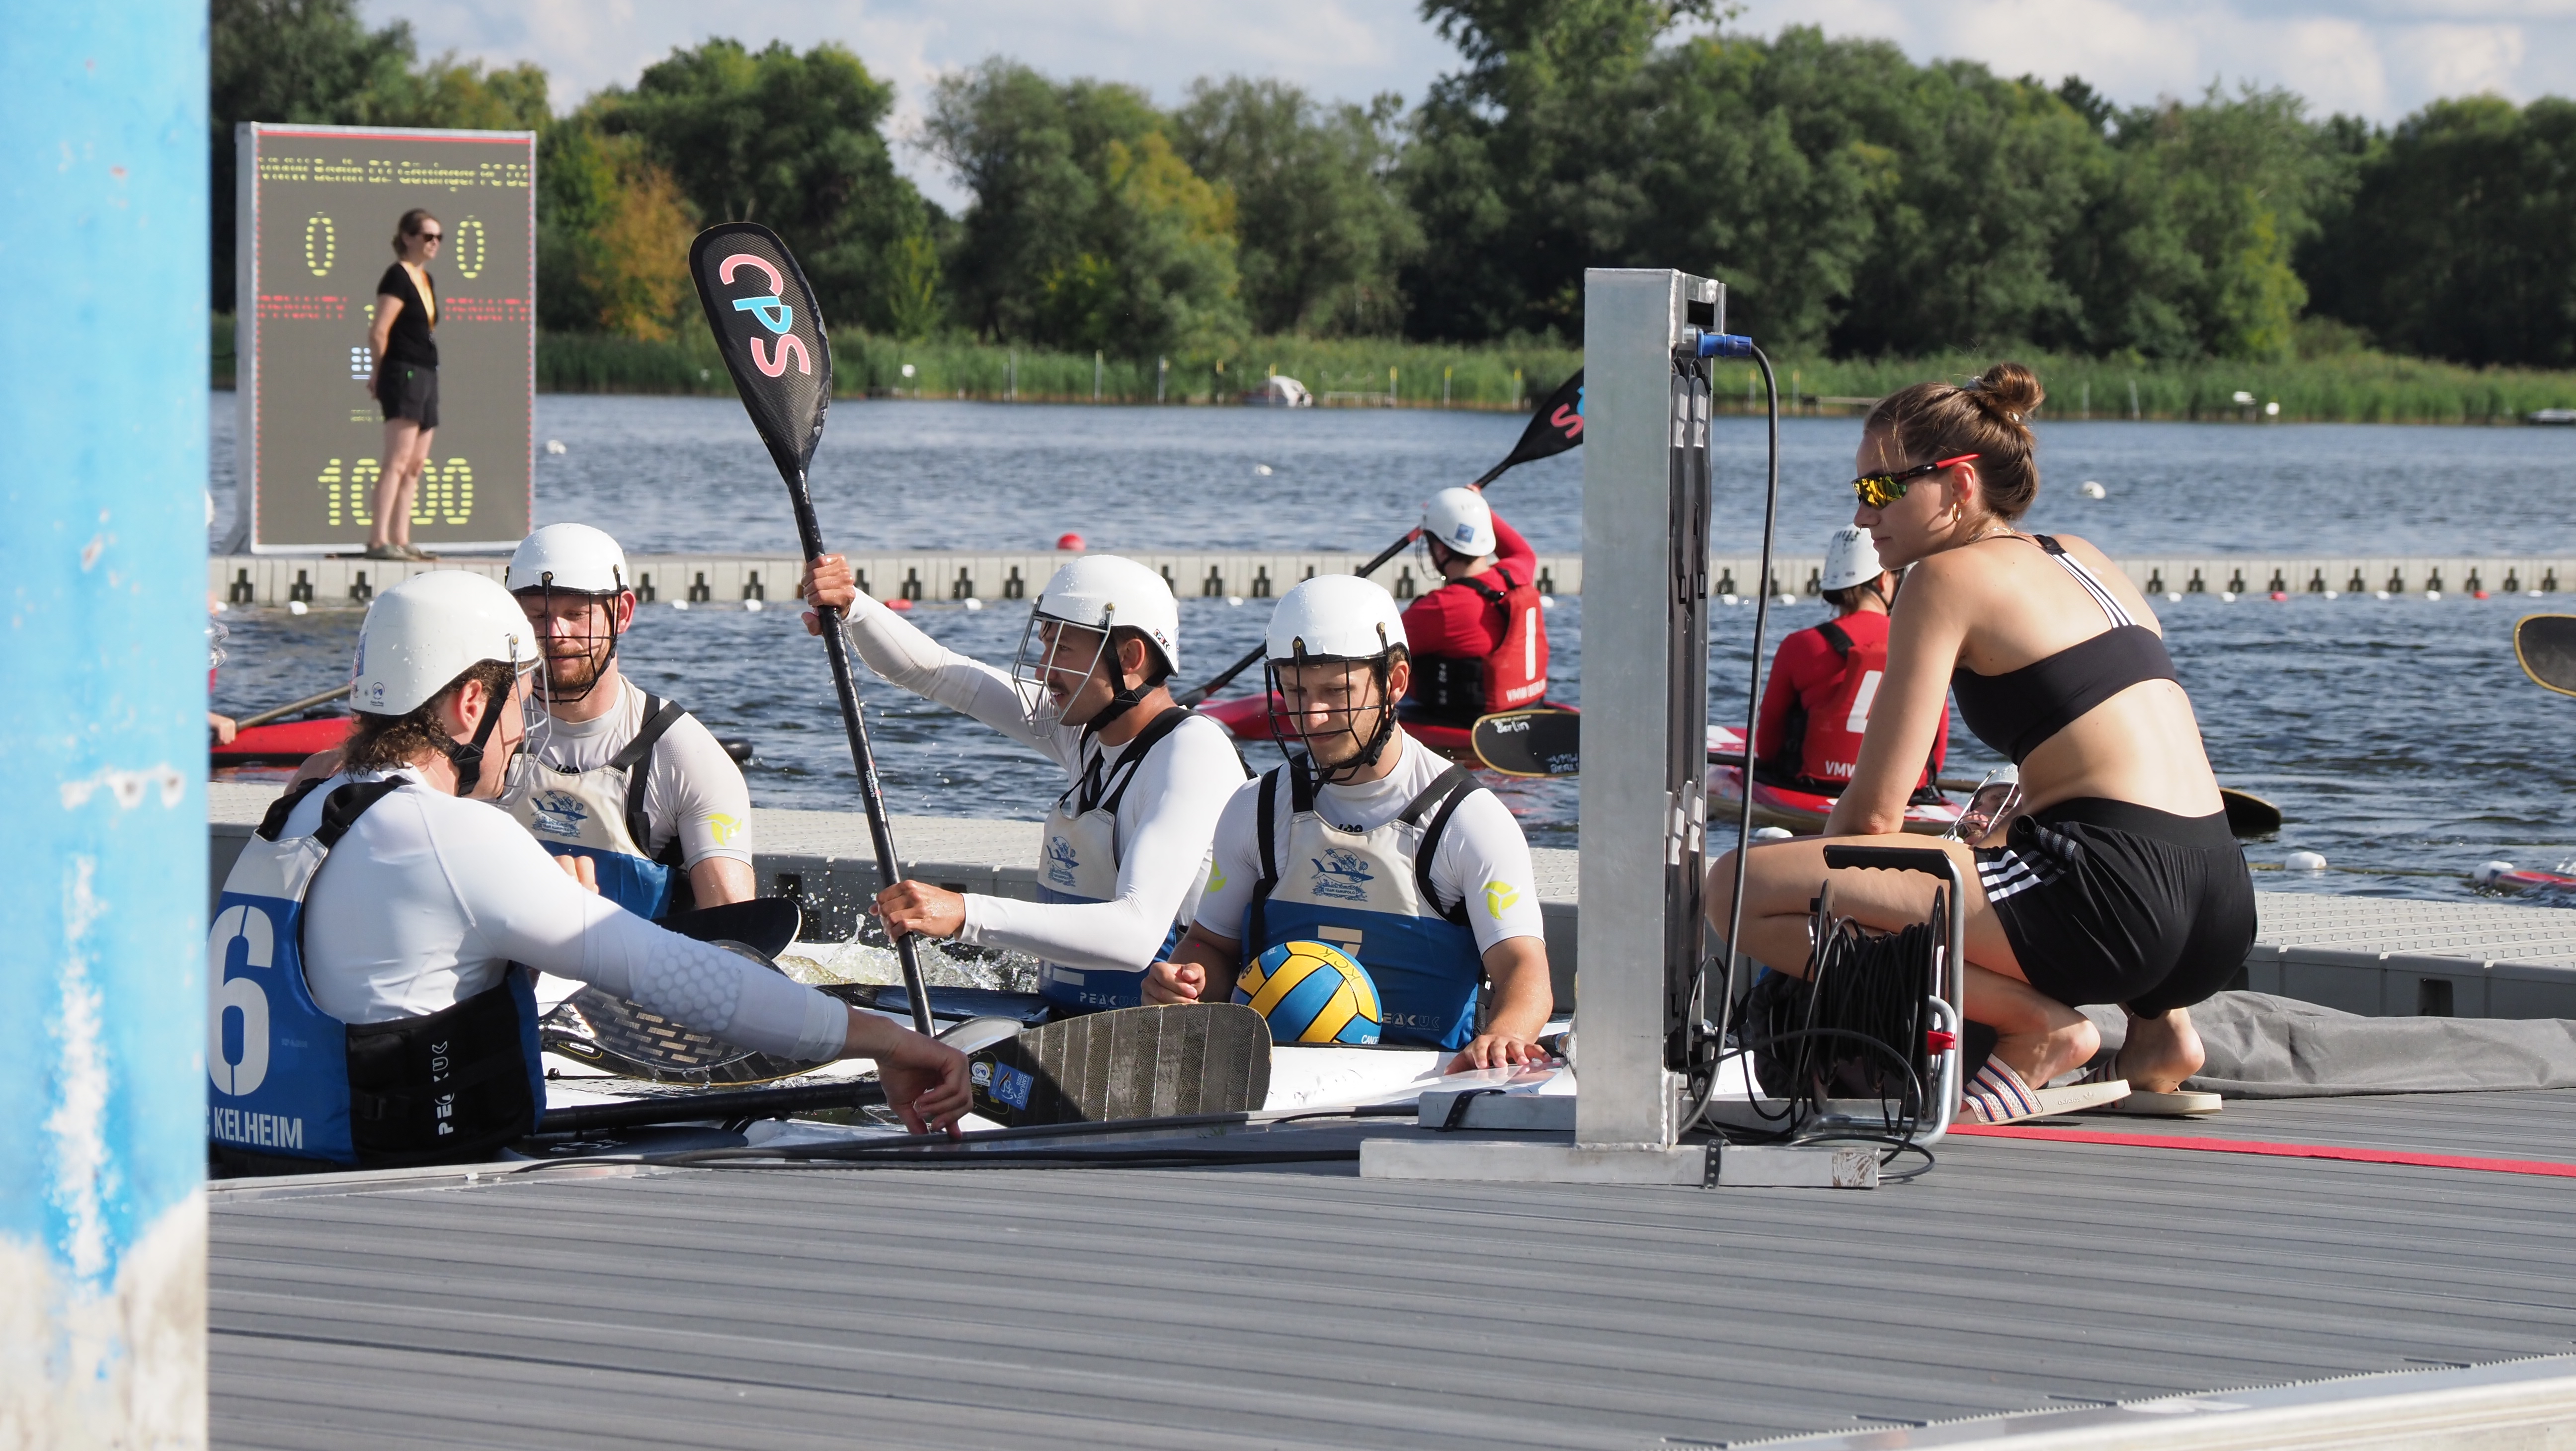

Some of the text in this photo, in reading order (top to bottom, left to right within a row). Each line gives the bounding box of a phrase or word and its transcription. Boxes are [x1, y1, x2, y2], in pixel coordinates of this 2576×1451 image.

[314, 158, 364, 182] Berlin
[305, 211, 335, 276] 0
[456, 215, 485, 278] 0
[720, 253, 811, 377] CPS
[1526, 607, 1536, 680] 1
[1494, 721, 1530, 733] Berlin
[206, 905, 273, 1096] 6
[1080, 991, 1117, 1007] PEAK
[1382, 1012, 1440, 1028] EAK UK
[2058, 1097, 2082, 1105] adidas
[214, 1107, 303, 1149] KELHEIM
